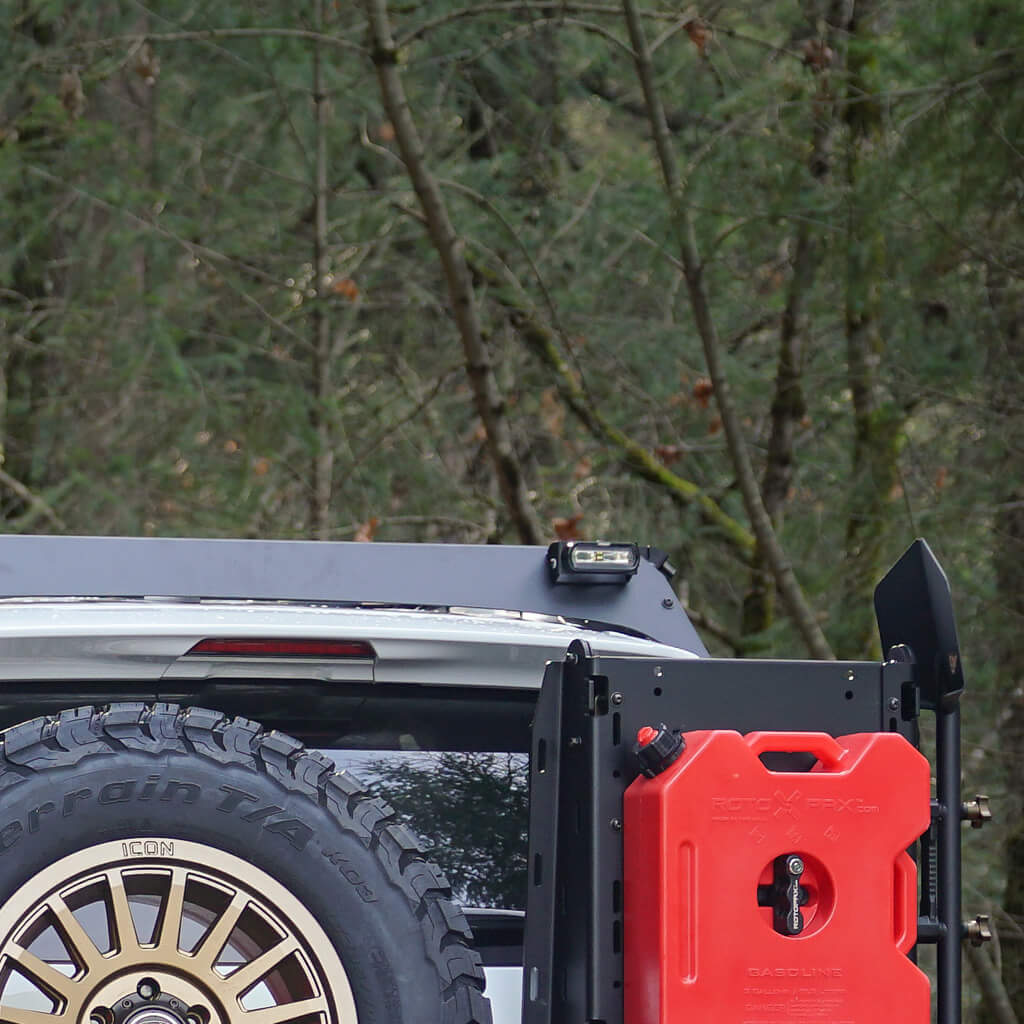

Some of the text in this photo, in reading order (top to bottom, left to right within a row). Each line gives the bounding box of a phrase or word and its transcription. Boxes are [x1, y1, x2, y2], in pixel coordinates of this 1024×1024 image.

[216, 784, 315, 850] T/A
[121, 840, 175, 857] ICON
[747, 967, 843, 978] GASOLINE
